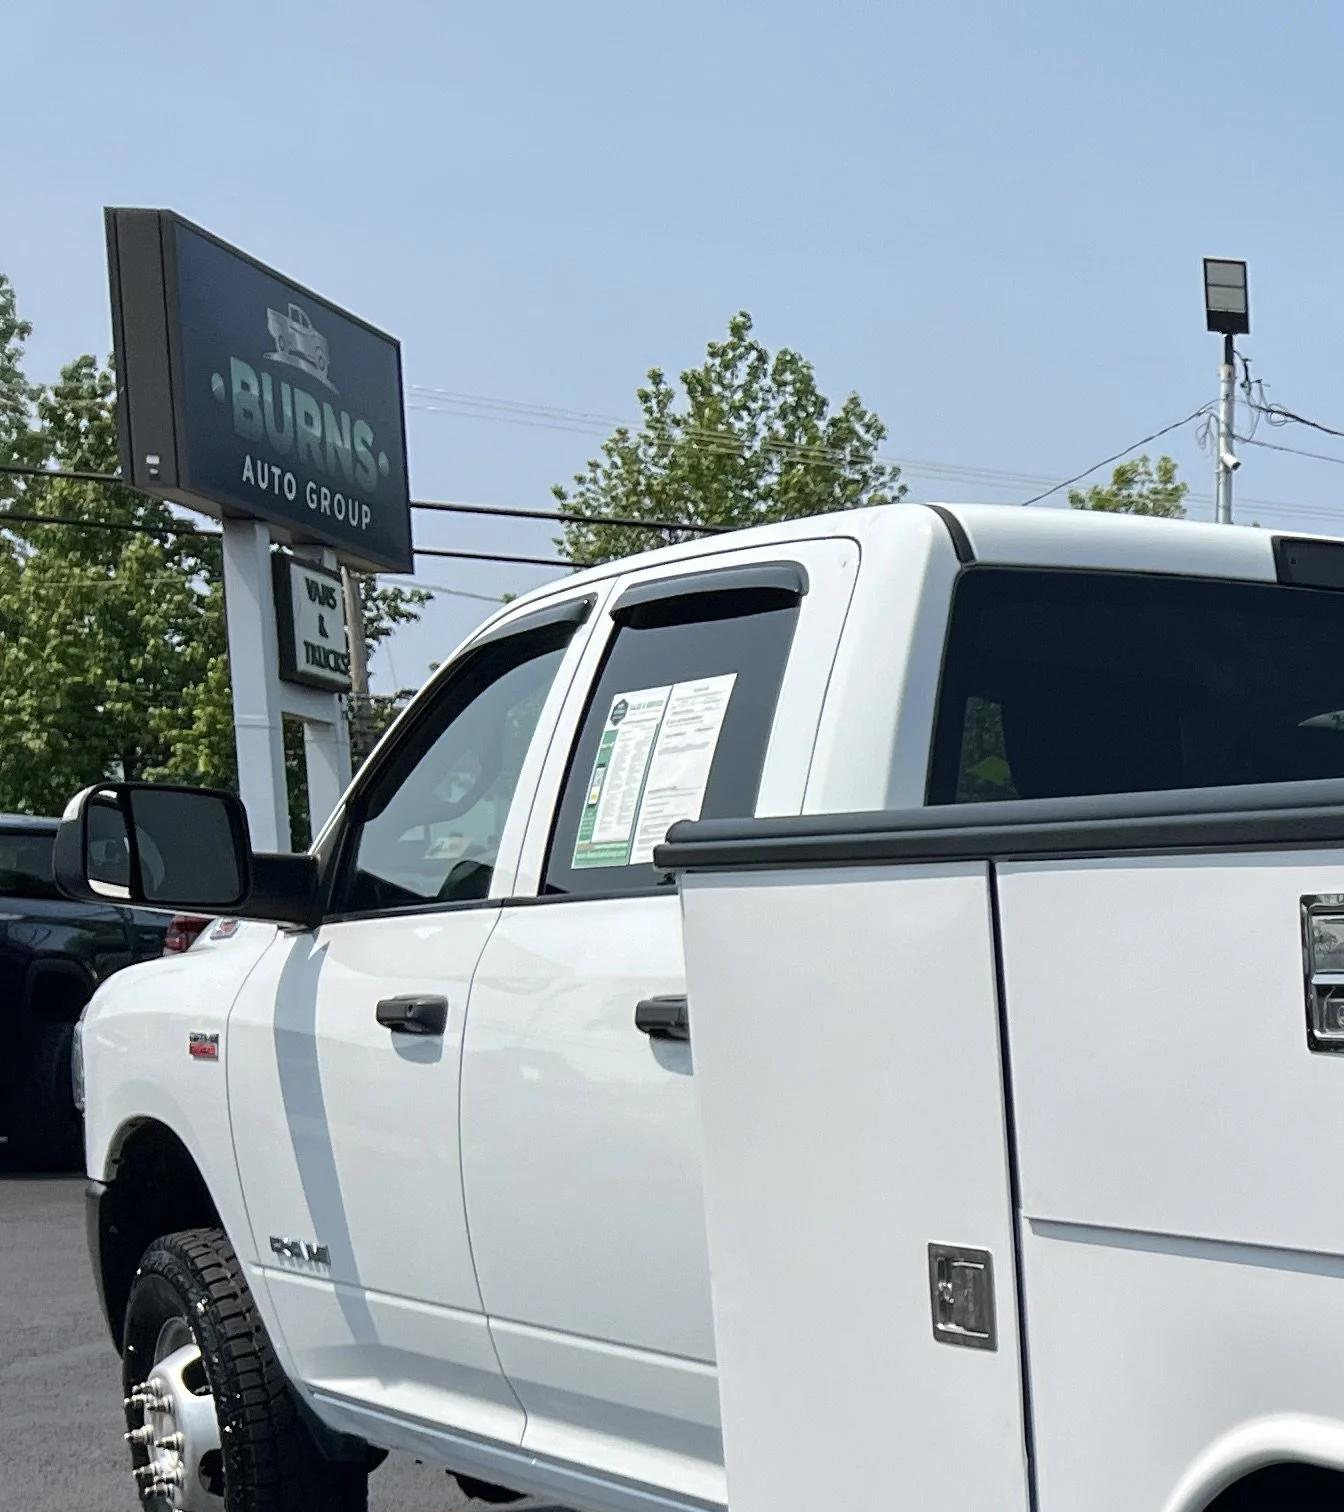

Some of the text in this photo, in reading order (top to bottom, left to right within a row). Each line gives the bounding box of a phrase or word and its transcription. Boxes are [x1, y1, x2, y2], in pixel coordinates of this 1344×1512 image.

[230, 356, 378, 494] BURNS
[242, 454, 371, 531] AUTO GROUP
